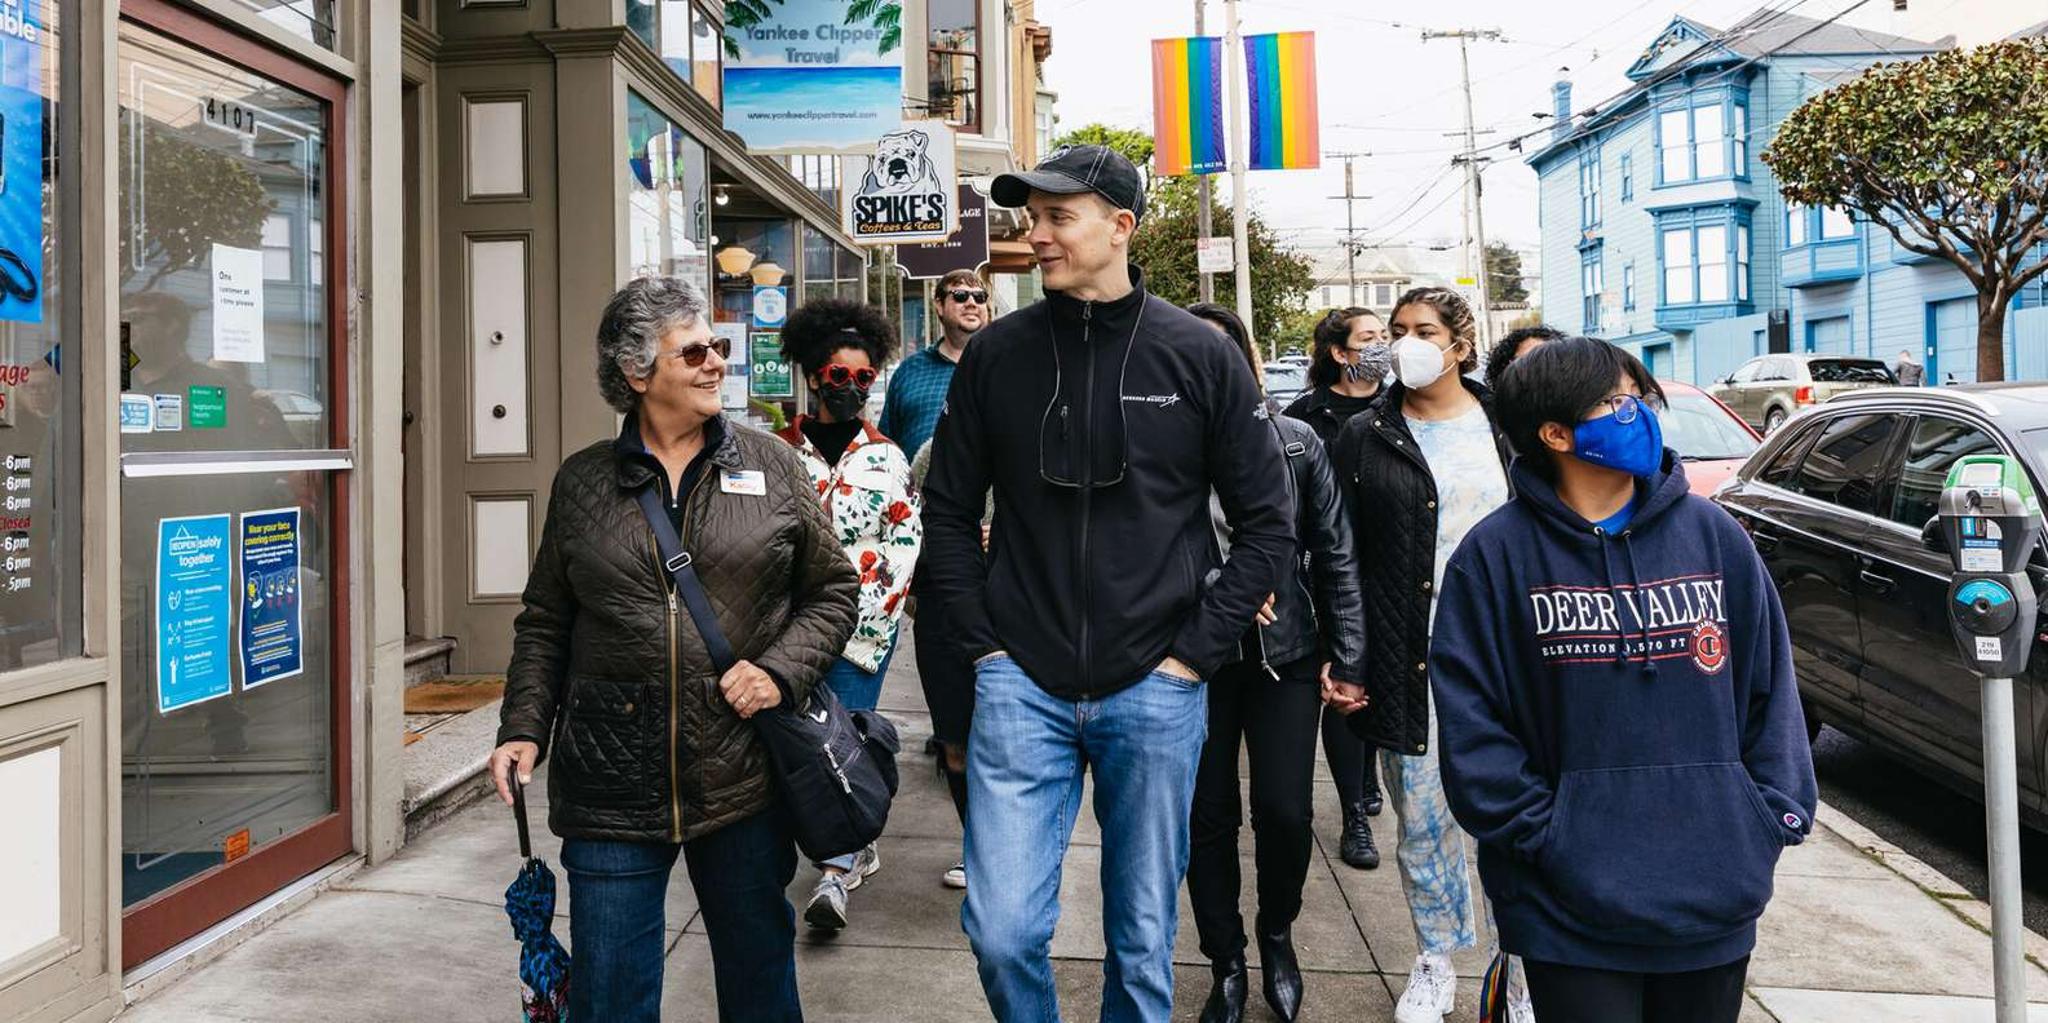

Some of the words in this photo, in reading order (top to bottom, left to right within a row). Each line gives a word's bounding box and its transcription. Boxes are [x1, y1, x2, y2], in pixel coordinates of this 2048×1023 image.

[747, 24, 809, 41] Yankee
[816, 24, 882, 45] Clipper
[785, 47, 840, 64] Travel
[207, 98, 254, 134] 4107
[856, 194, 943, 223] SPIKE'S
[860, 223, 901, 233] Coffees
[903, 222, 913, 231] &
[915, 221, 941, 230] Teas
[1530, 591, 1620, 635] DEER
[1622, 580, 1727, 629] VALLEY
[1542, 643, 1616, 656] ELEVATION
[1670, 638, 1686, 648] FT
